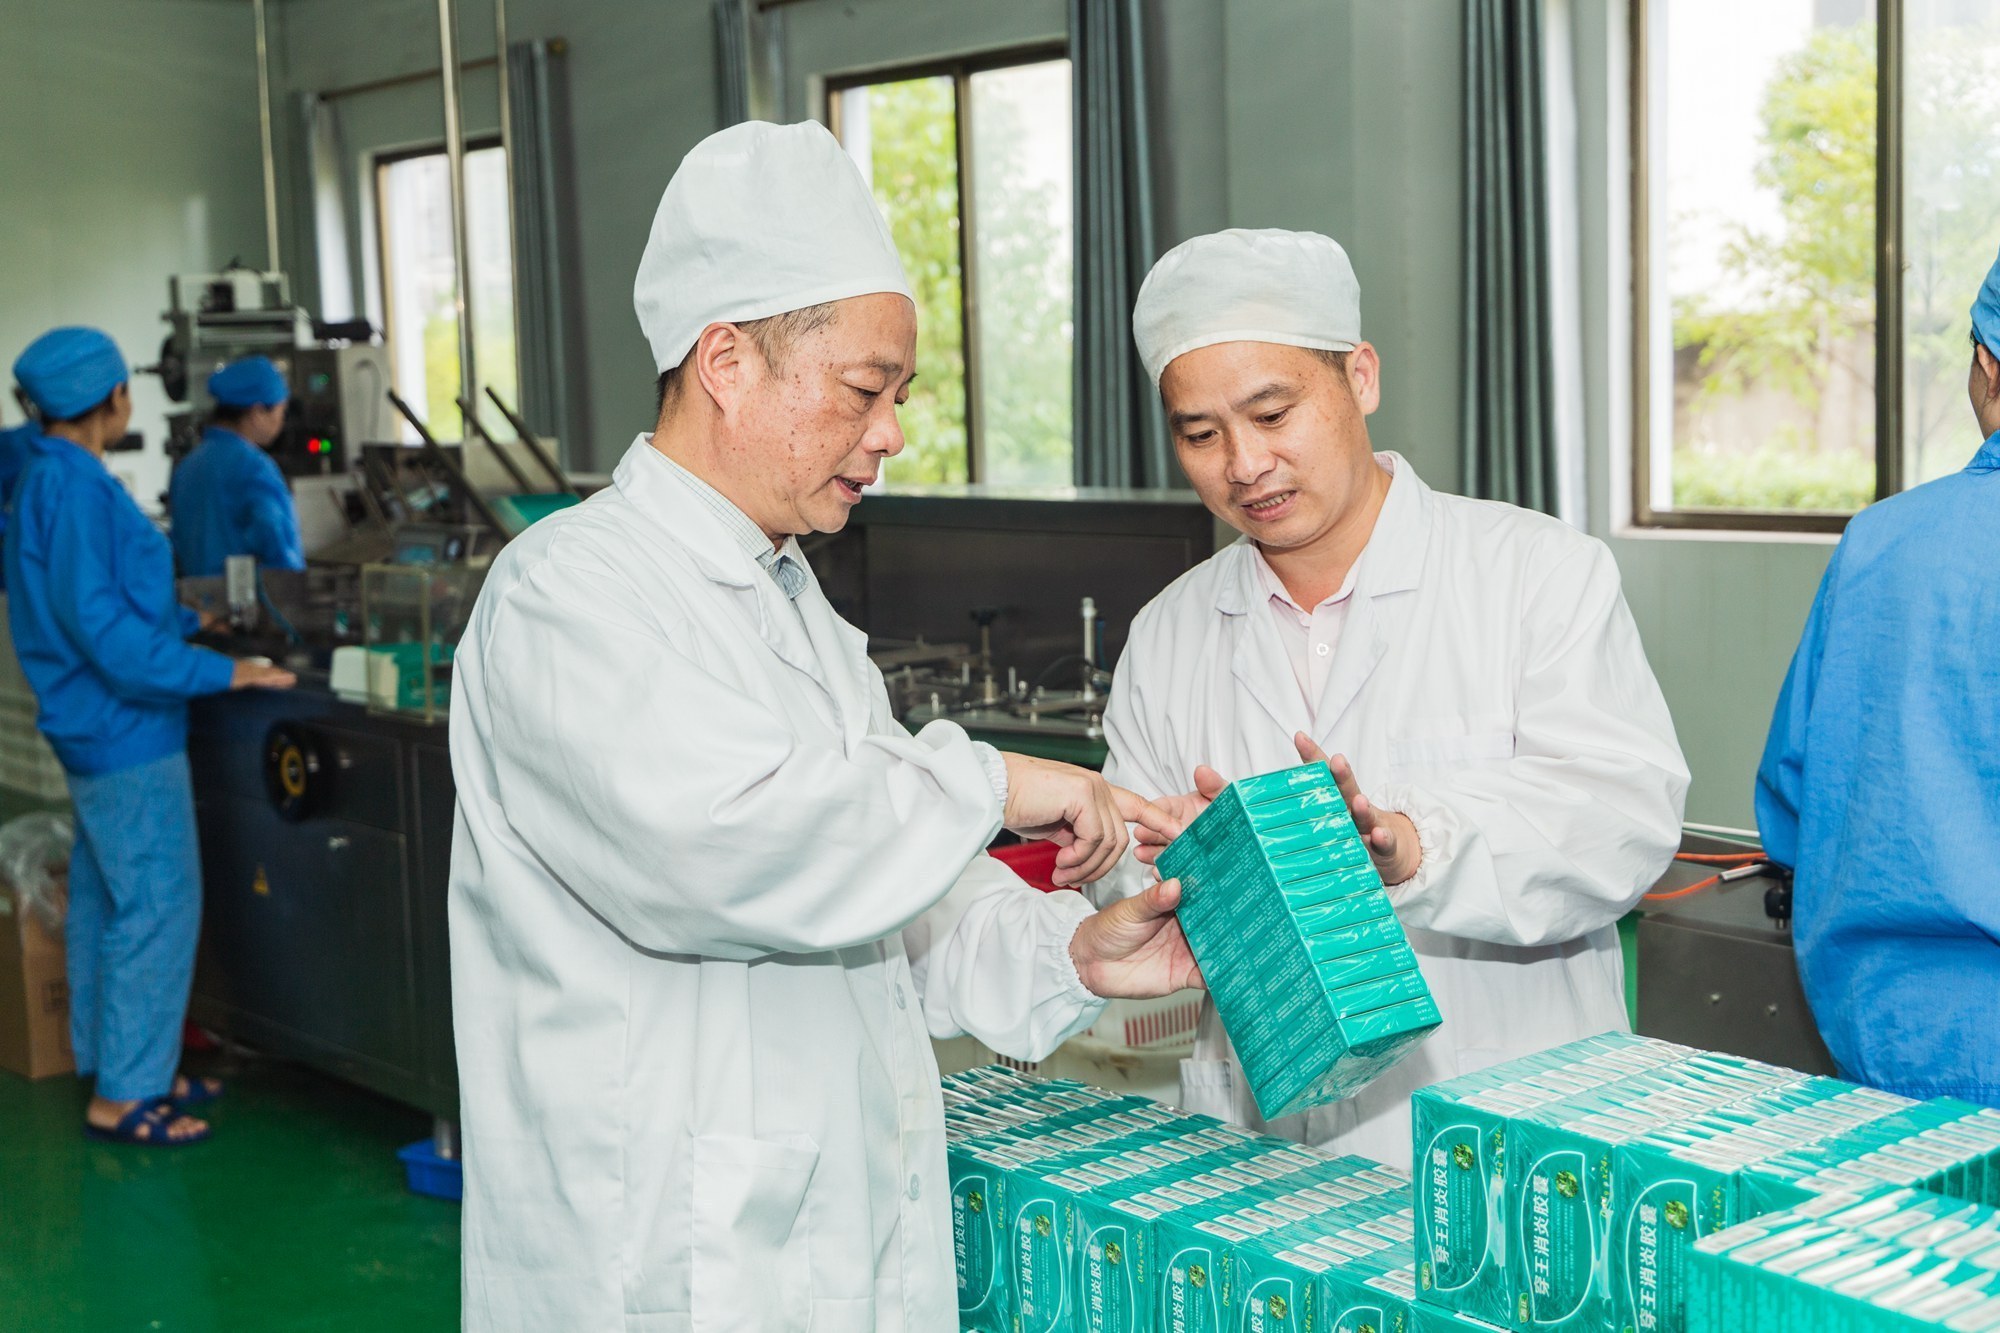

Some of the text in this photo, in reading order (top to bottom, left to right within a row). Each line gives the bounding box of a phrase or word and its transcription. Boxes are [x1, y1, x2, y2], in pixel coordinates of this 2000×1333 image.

[952, 1193, 968, 1290] 穿王消炎胶囊
[1432, 1147, 1450, 1266] 穿王消炎胶囊
[1532, 1174, 1550, 1297] 穿王消炎胶囊
[1020, 1217, 1035, 1317] 穿王消炎胶囊
[1638, 1203, 1657, 1331] 穿王消炎胶囊
